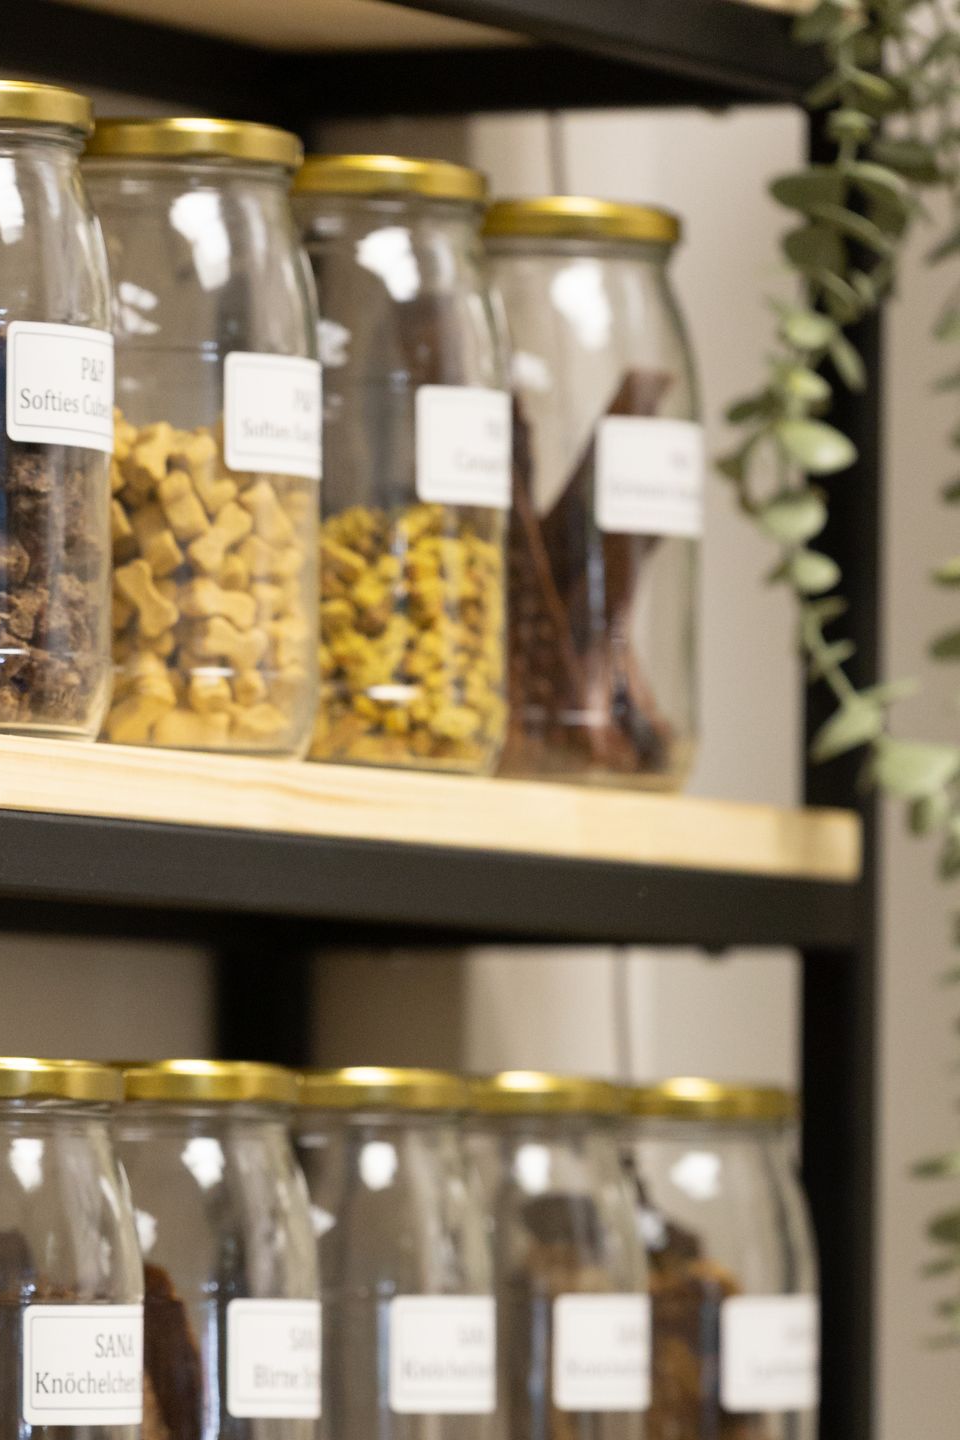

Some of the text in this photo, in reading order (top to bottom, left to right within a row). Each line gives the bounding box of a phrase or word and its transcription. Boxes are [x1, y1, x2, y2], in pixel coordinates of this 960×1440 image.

[81, 357, 105, 382] P&P
[20, 387, 79, 413] Softies
[94, 1333, 135, 1358] SANA
[35, 1371, 137, 1395] Knöchelchen
